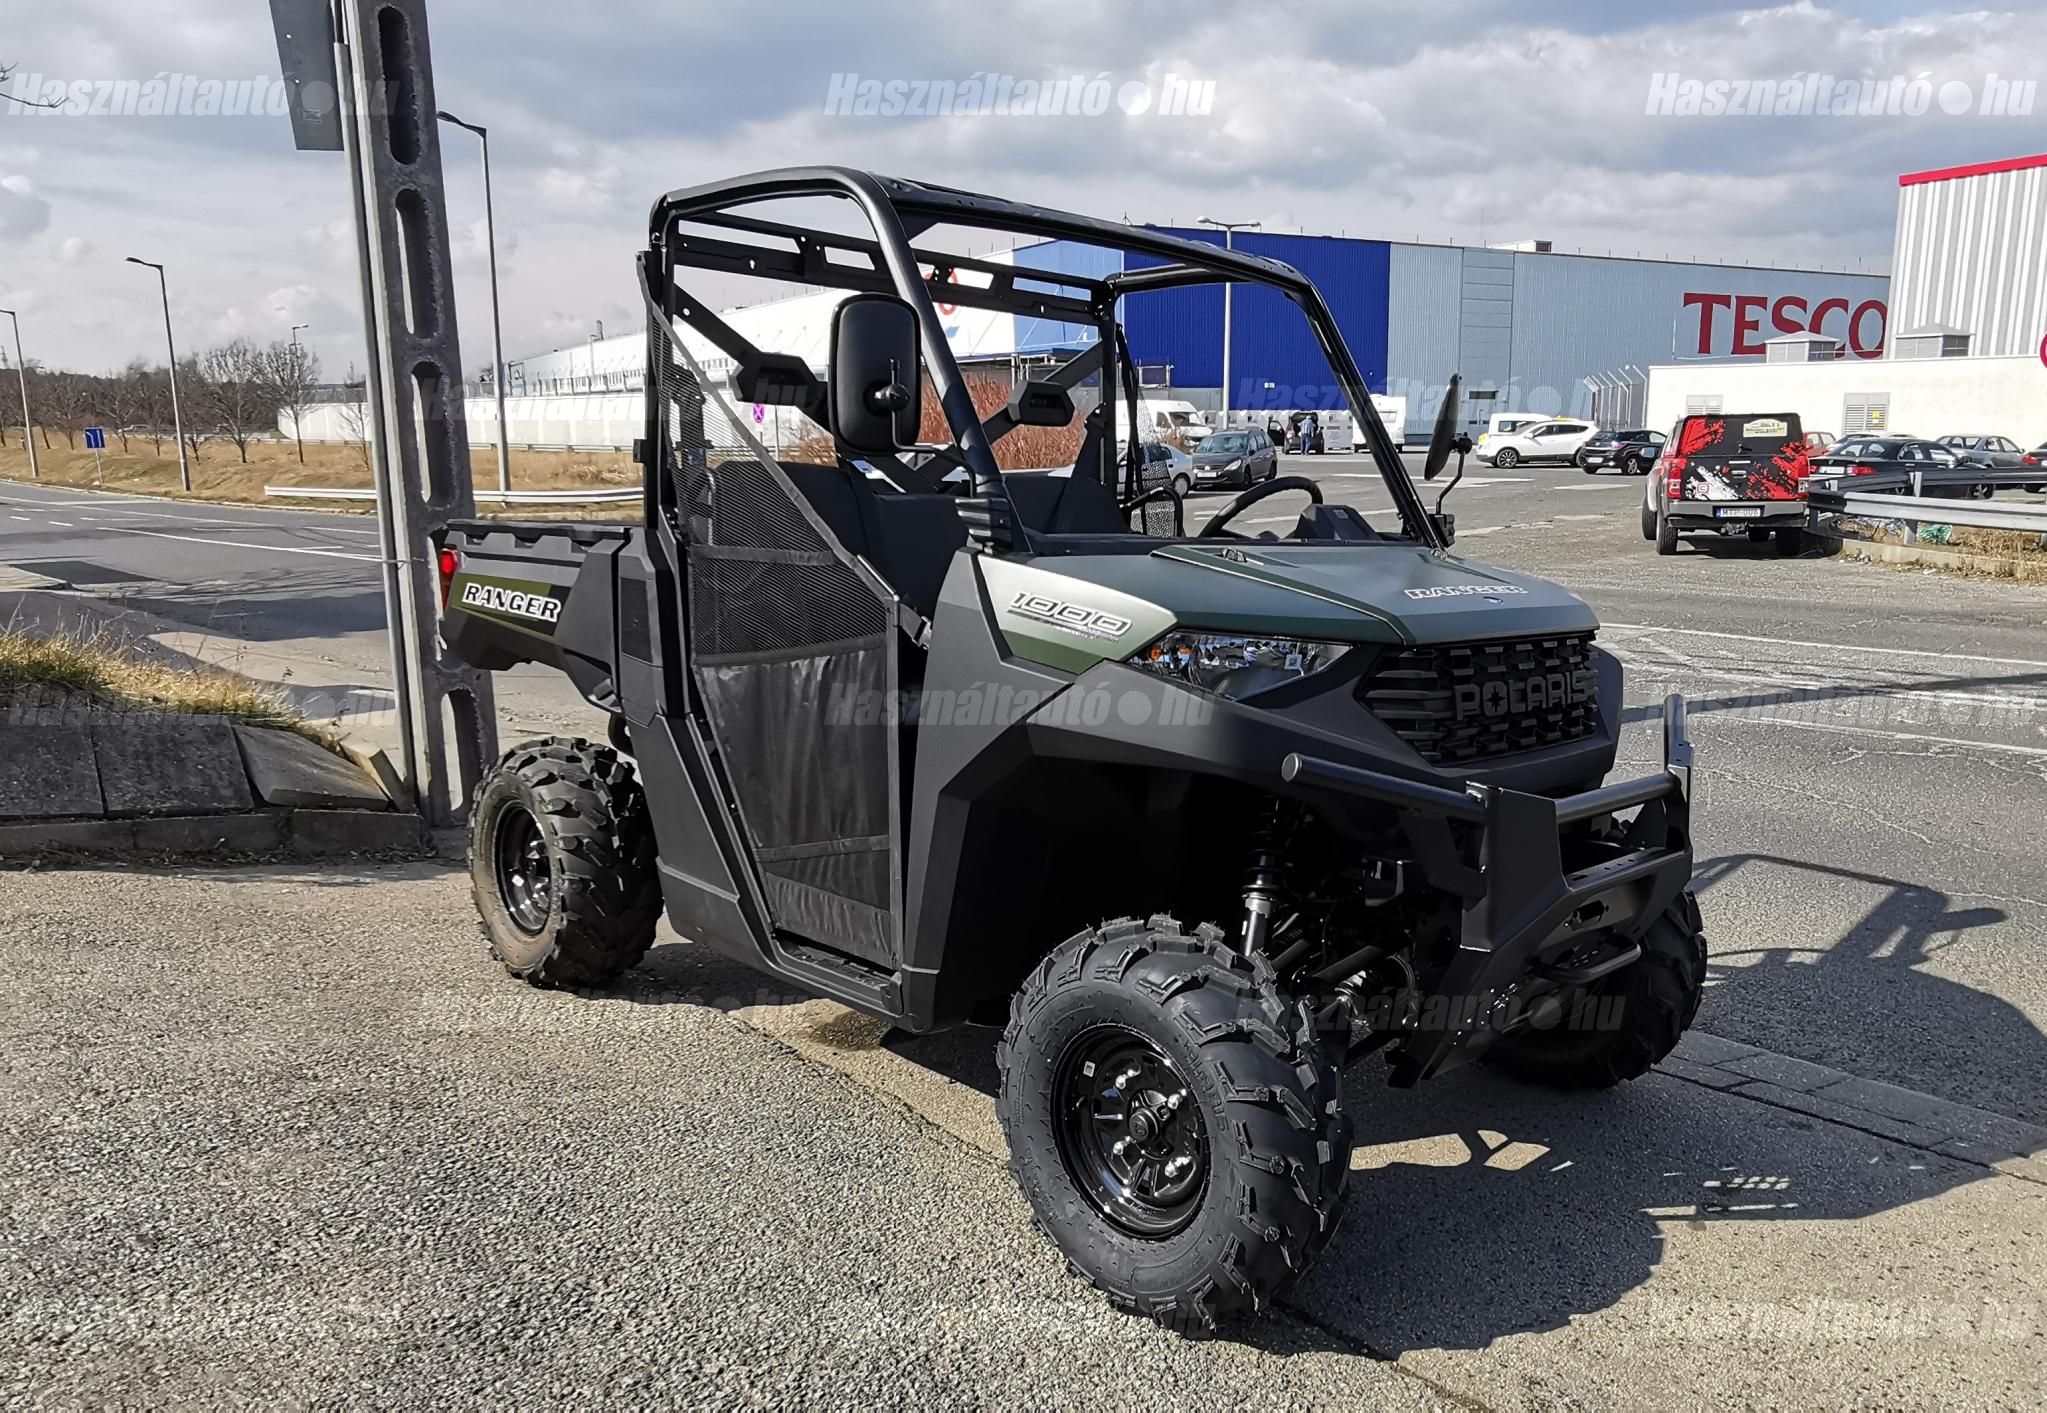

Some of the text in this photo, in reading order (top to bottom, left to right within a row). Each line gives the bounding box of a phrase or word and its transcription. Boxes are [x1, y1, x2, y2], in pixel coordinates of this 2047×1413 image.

[1683, 292, 1888, 360] TESCO
[462, 583, 562, 622] RANGER
[1009, 592, 1133, 637] 1000
[1404, 584, 1529, 600] RANGER
[1456, 670, 1591, 721] POLARIS
